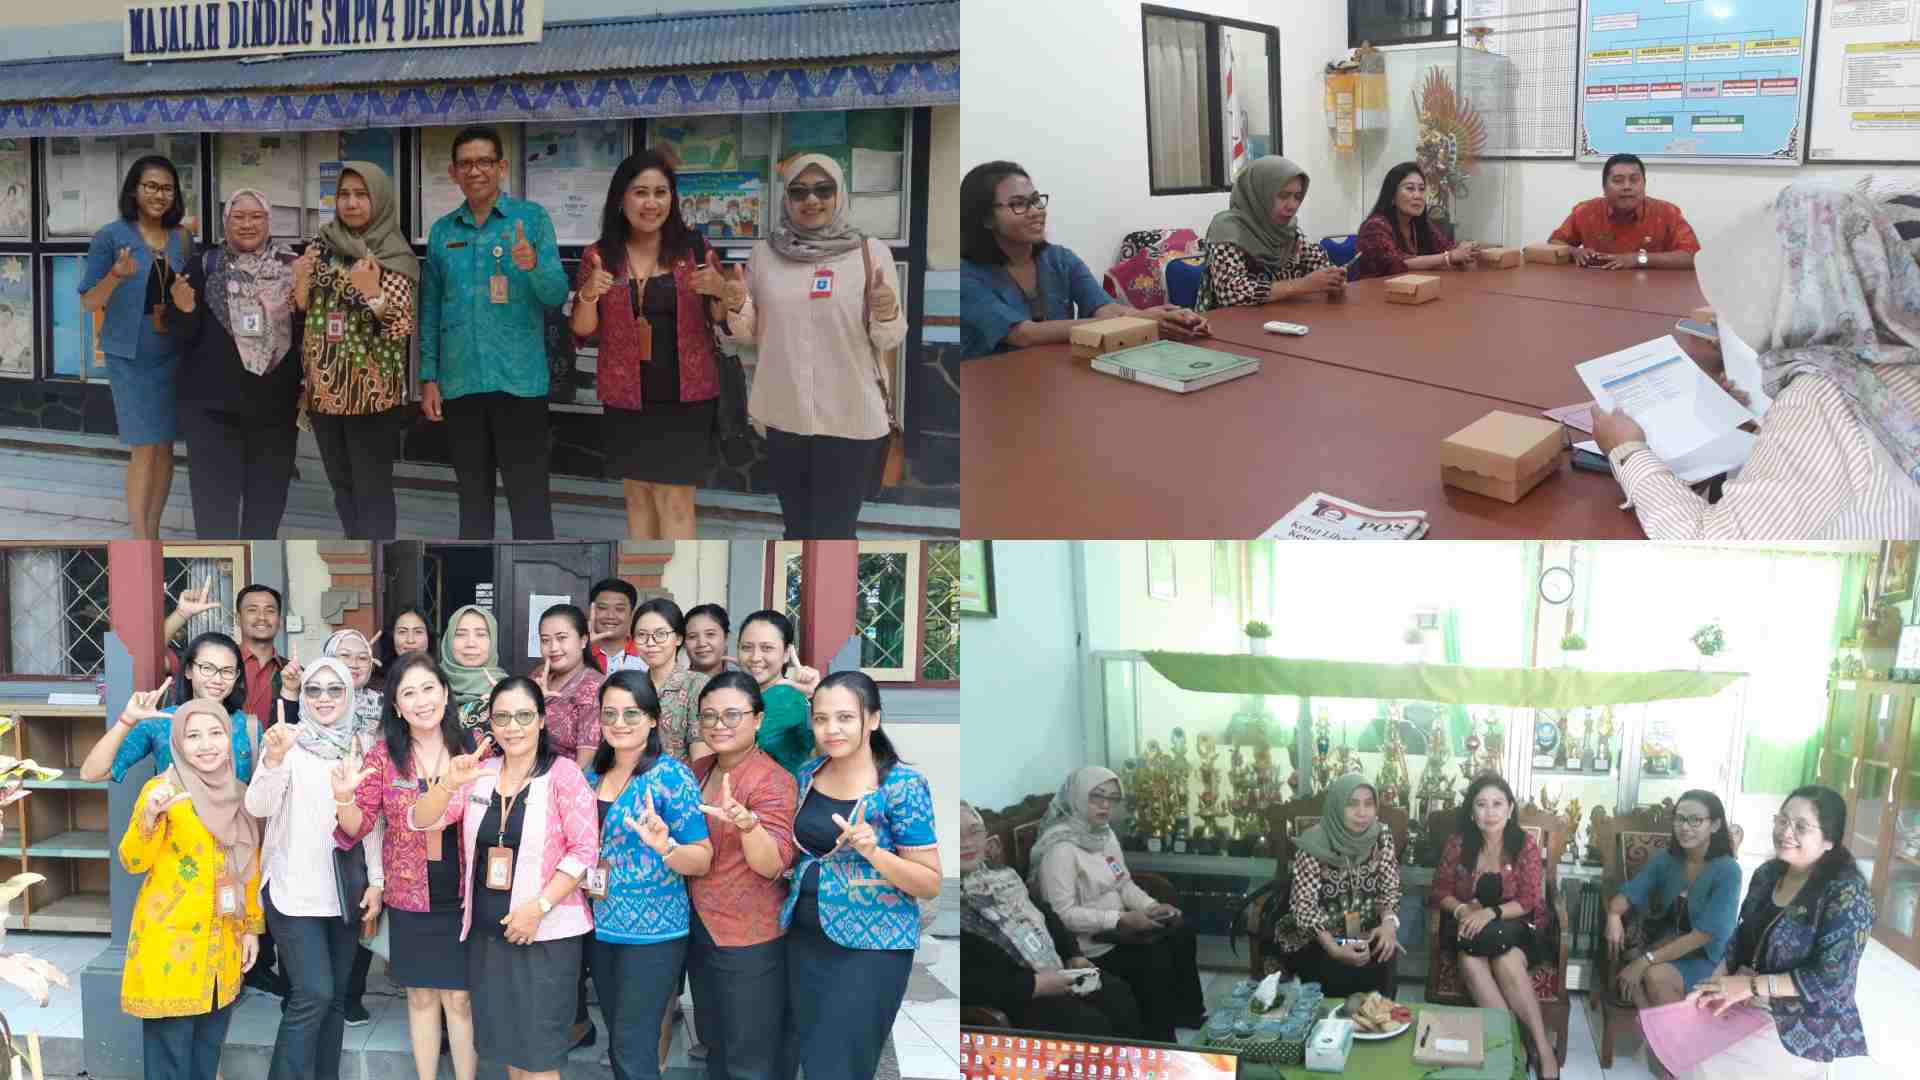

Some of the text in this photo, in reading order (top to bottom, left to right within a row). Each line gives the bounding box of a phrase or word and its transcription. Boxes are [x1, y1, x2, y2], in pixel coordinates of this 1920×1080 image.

[128, 0, 525, 54] MAJALAH DINDING SMPN 4 DENPASAR
